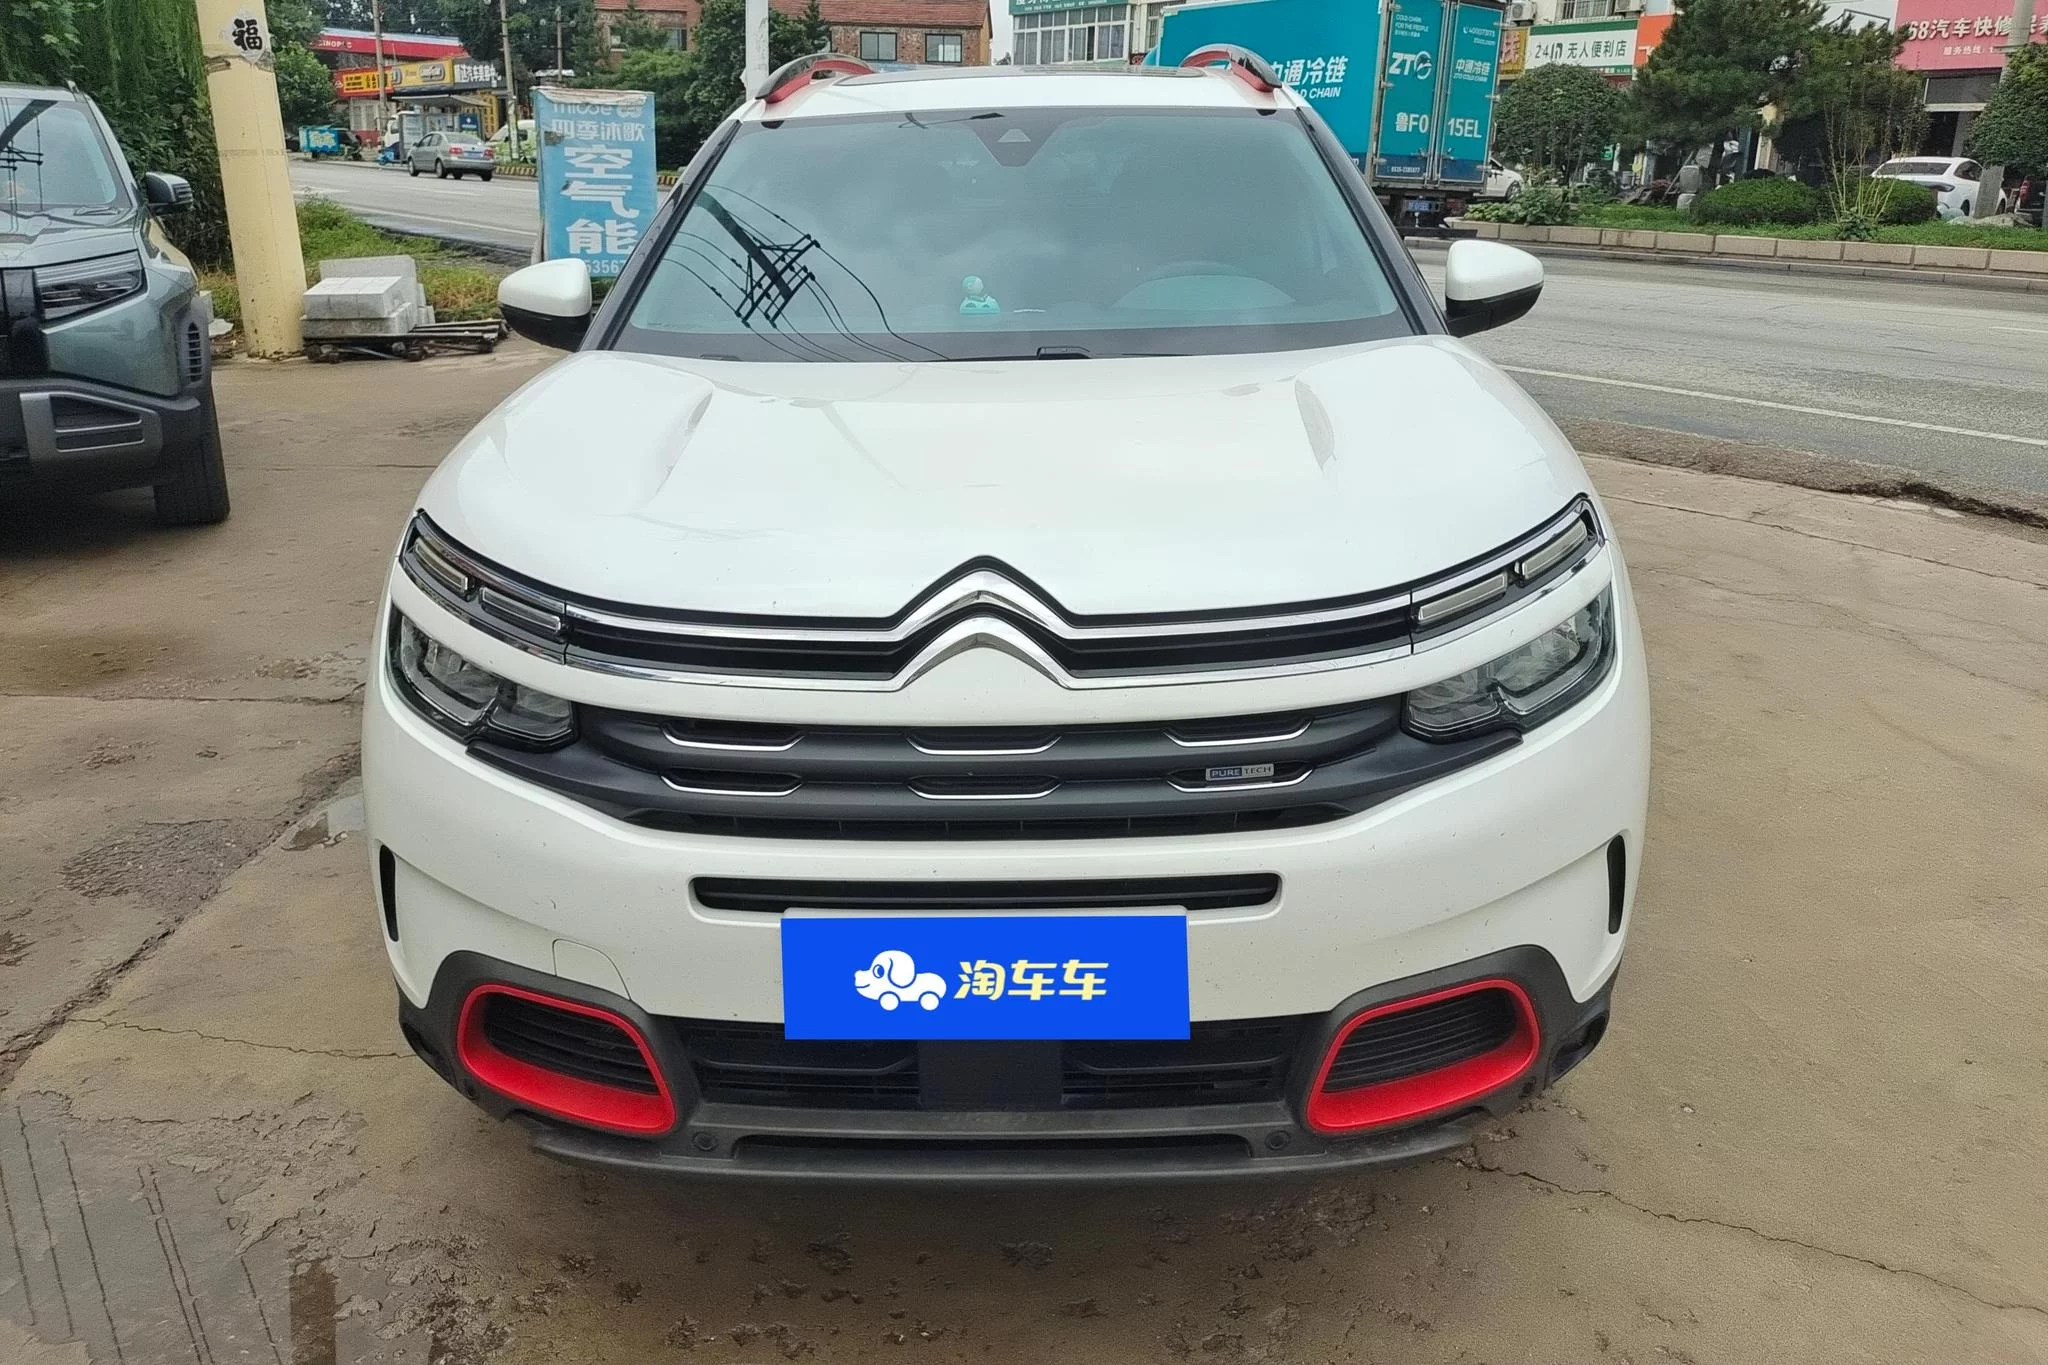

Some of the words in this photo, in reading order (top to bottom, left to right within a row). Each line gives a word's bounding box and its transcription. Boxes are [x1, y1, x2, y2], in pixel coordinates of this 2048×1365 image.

[232, 18, 262, 51] 福
[1906, 14, 2048, 40] 68汽车快修
[318, 39, 353, 49] SINOPC
[1567, 40, 1628, 60] 无人便利店
[1389, 50, 1432, 80] ZTO
[1456, 58, 1491, 76] 中通冷链
[1309, 87, 1342, 99] CHAIN
[552, 119, 646, 142] 四季沐歌
[1447, 117, 1482, 138] 15EL
[560, 144, 641, 255] 空气能
[585, 260, 626, 274] 356
[1211, 767, 1240, 778] PURE
